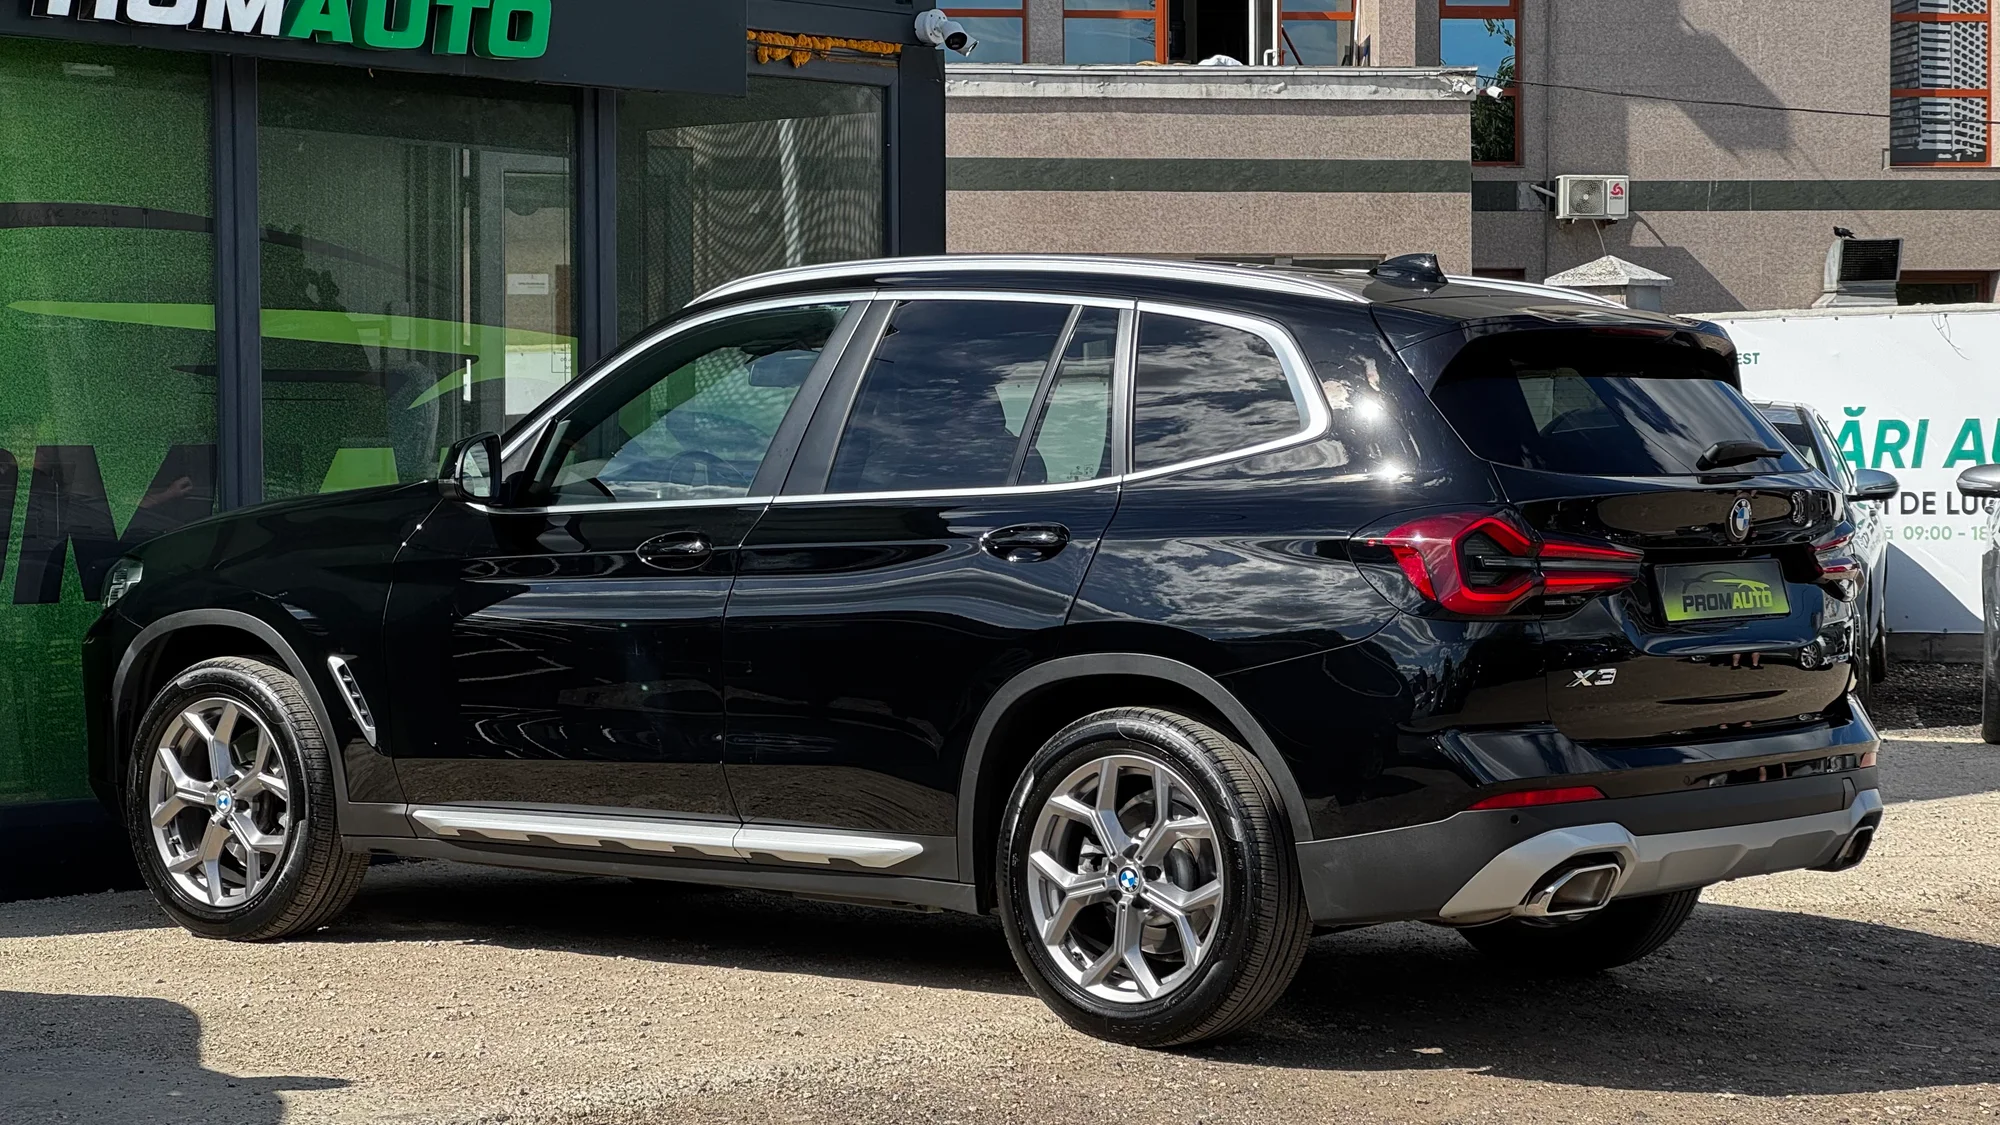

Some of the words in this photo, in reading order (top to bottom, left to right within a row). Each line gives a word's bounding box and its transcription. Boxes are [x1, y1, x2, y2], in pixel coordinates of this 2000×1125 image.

[1900, 491, 1937, 515] DE
[1903, 525, 1952, 541] 09:00
[1682, 591, 1773, 613] PROMAUTO
[1565, 668, 1617, 688] X3
